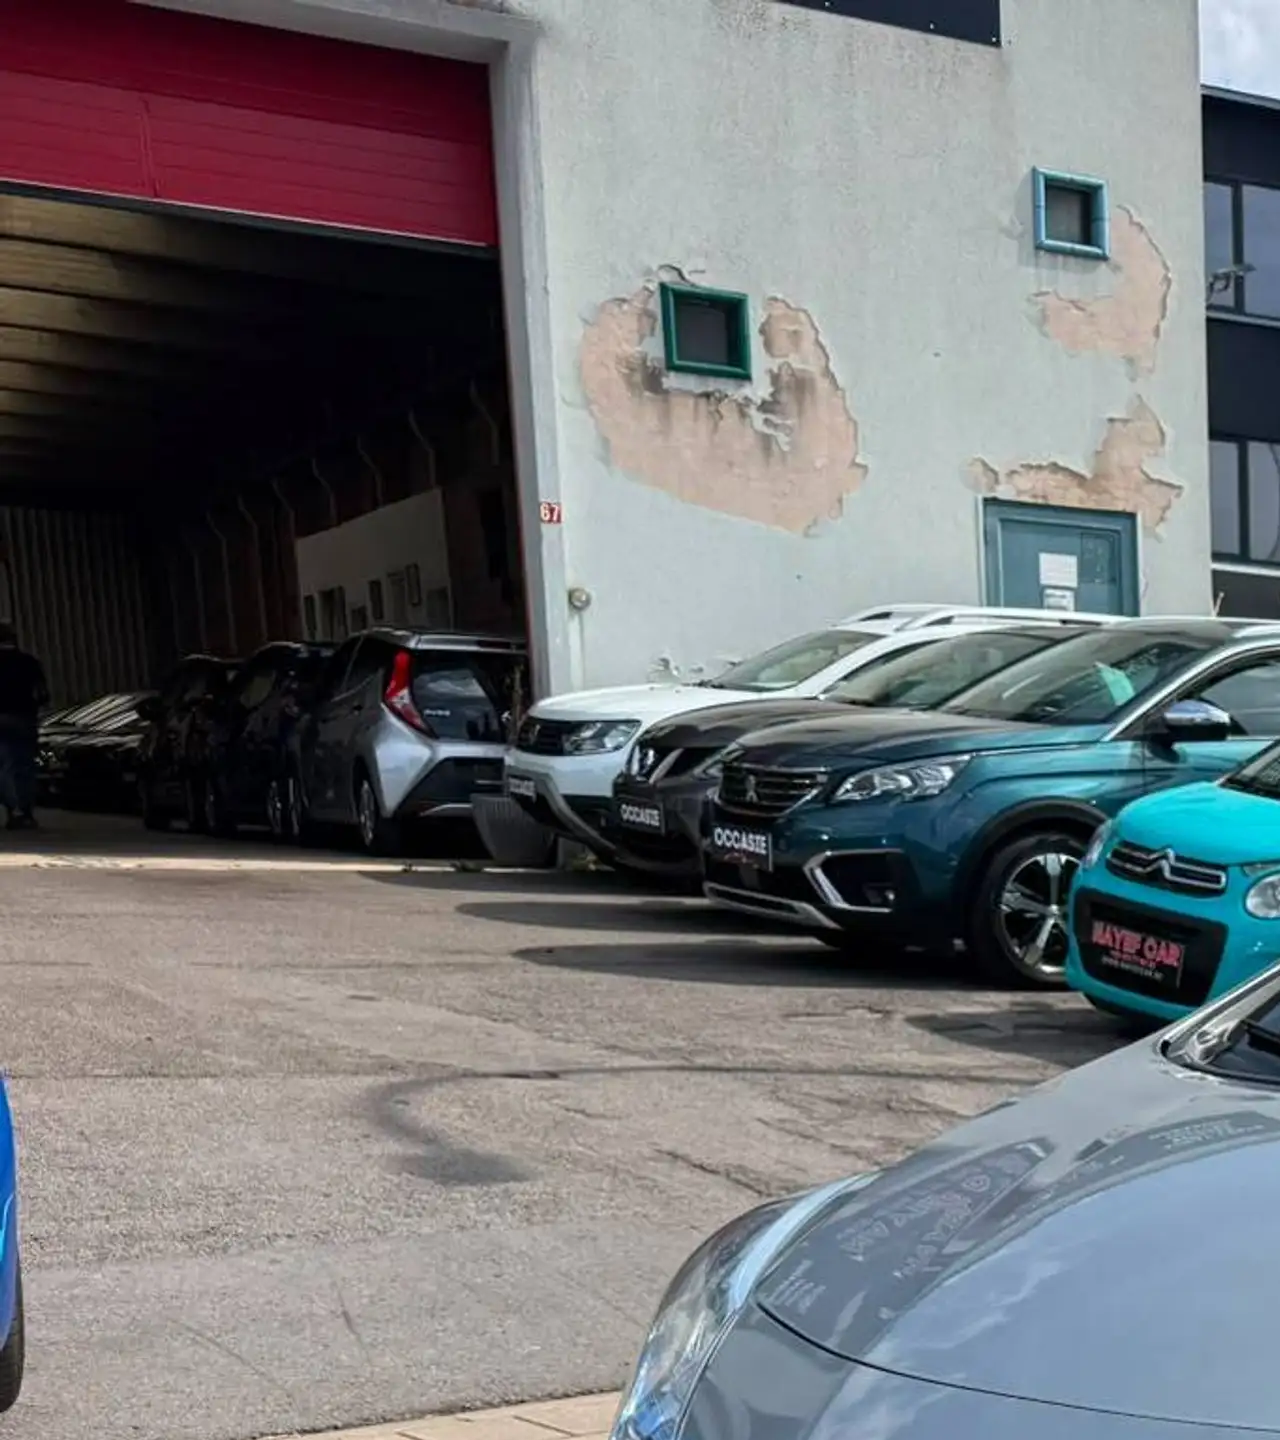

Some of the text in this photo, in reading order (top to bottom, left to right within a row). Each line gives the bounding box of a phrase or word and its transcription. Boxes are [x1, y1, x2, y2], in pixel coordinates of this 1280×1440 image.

[540, 502, 559, 521] 67
[620, 804, 660, 826] OCCASIE
[714, 827, 768, 854] OCCASIE
